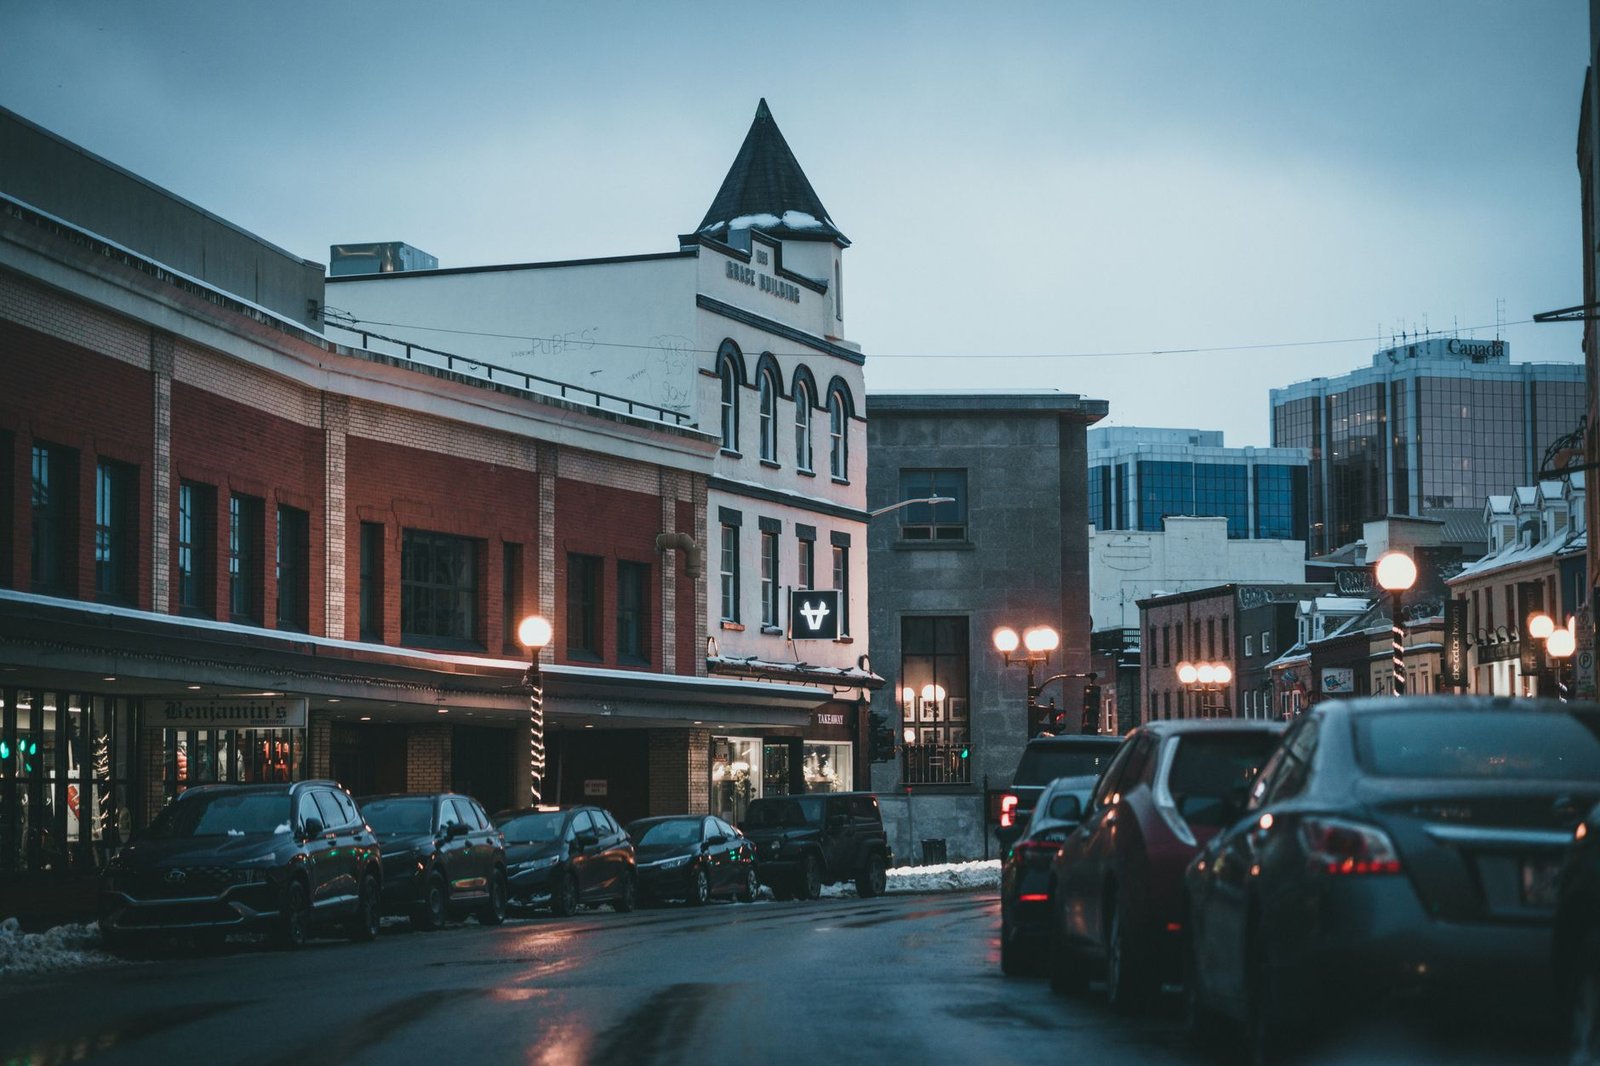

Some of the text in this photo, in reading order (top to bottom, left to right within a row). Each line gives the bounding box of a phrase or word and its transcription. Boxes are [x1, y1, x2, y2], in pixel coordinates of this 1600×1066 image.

[758, 272, 800, 304] BUILDING
[1448, 338, 1504, 357] Canada
[164, 701, 287, 722] Benjamin's
